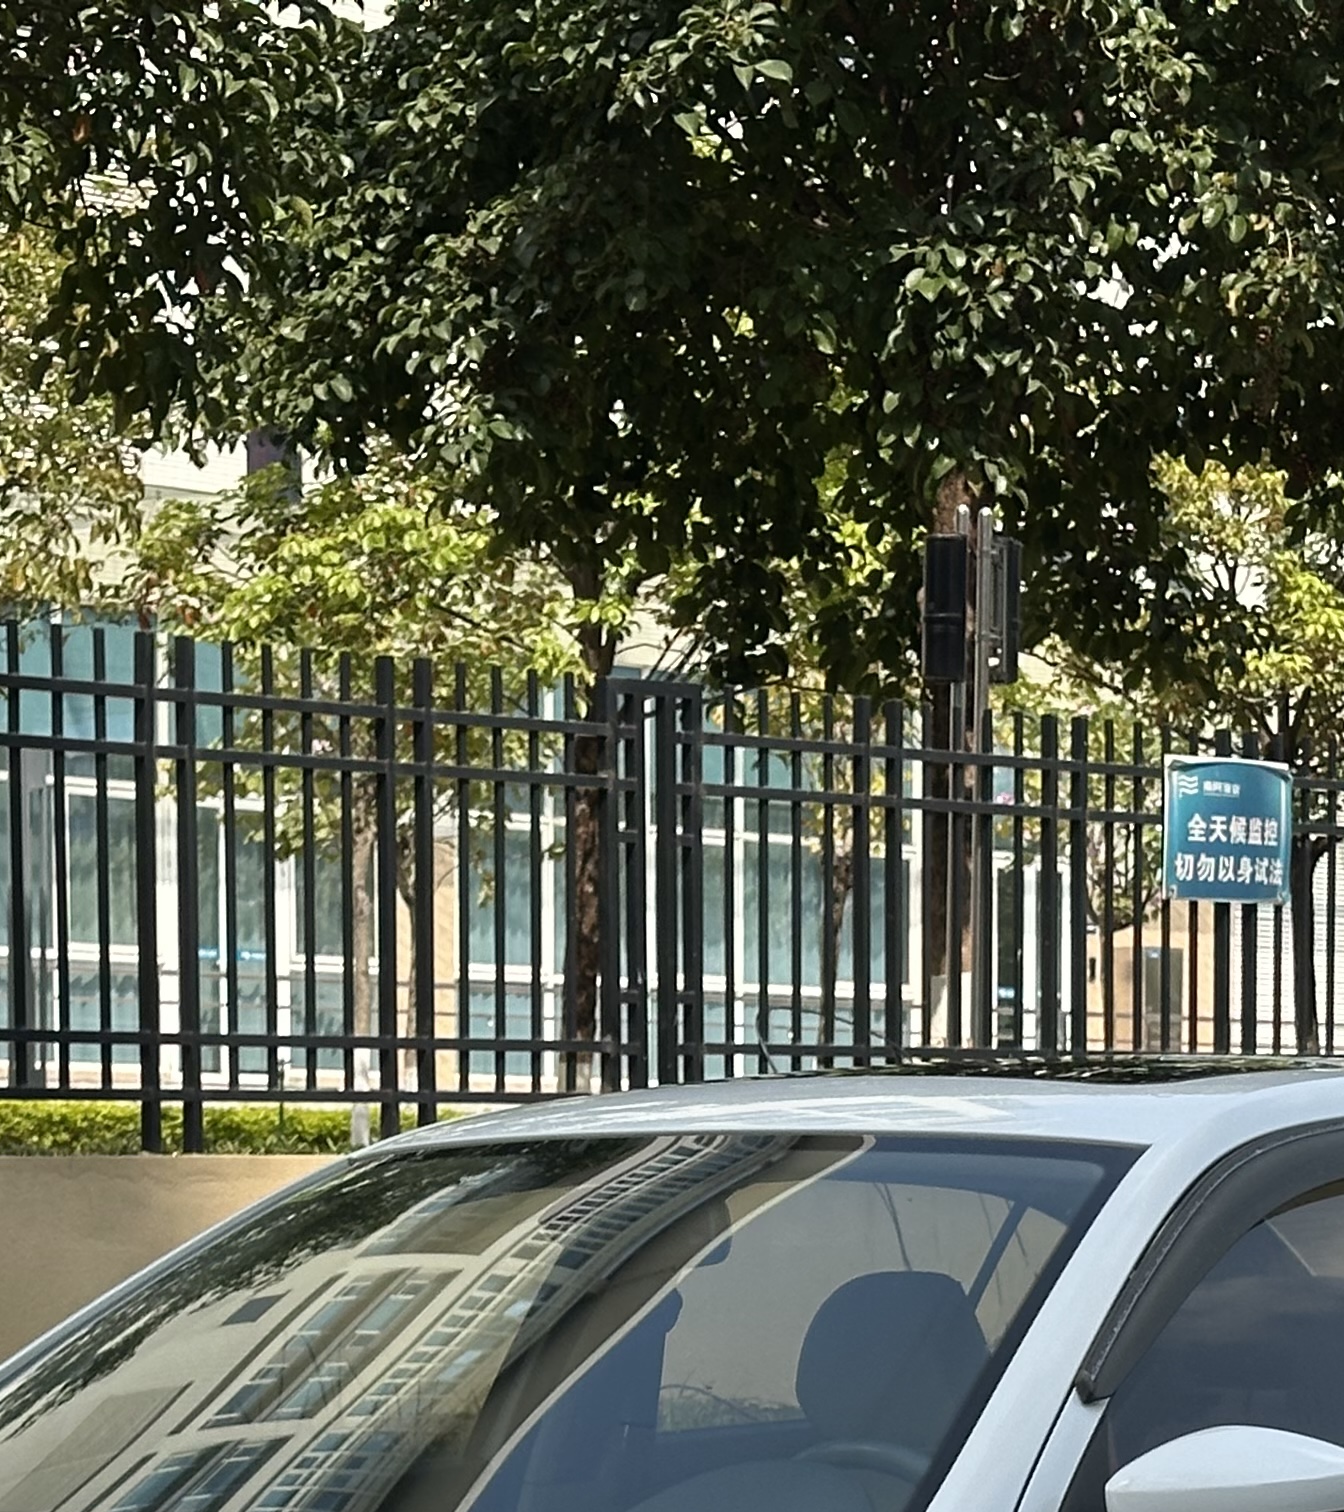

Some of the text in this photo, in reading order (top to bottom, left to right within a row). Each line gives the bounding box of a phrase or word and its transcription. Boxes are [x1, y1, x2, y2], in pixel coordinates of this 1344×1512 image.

[1187, 813, 1279, 846] 全天候监控
[1174, 853, 1284, 886] 切勿以身试法
